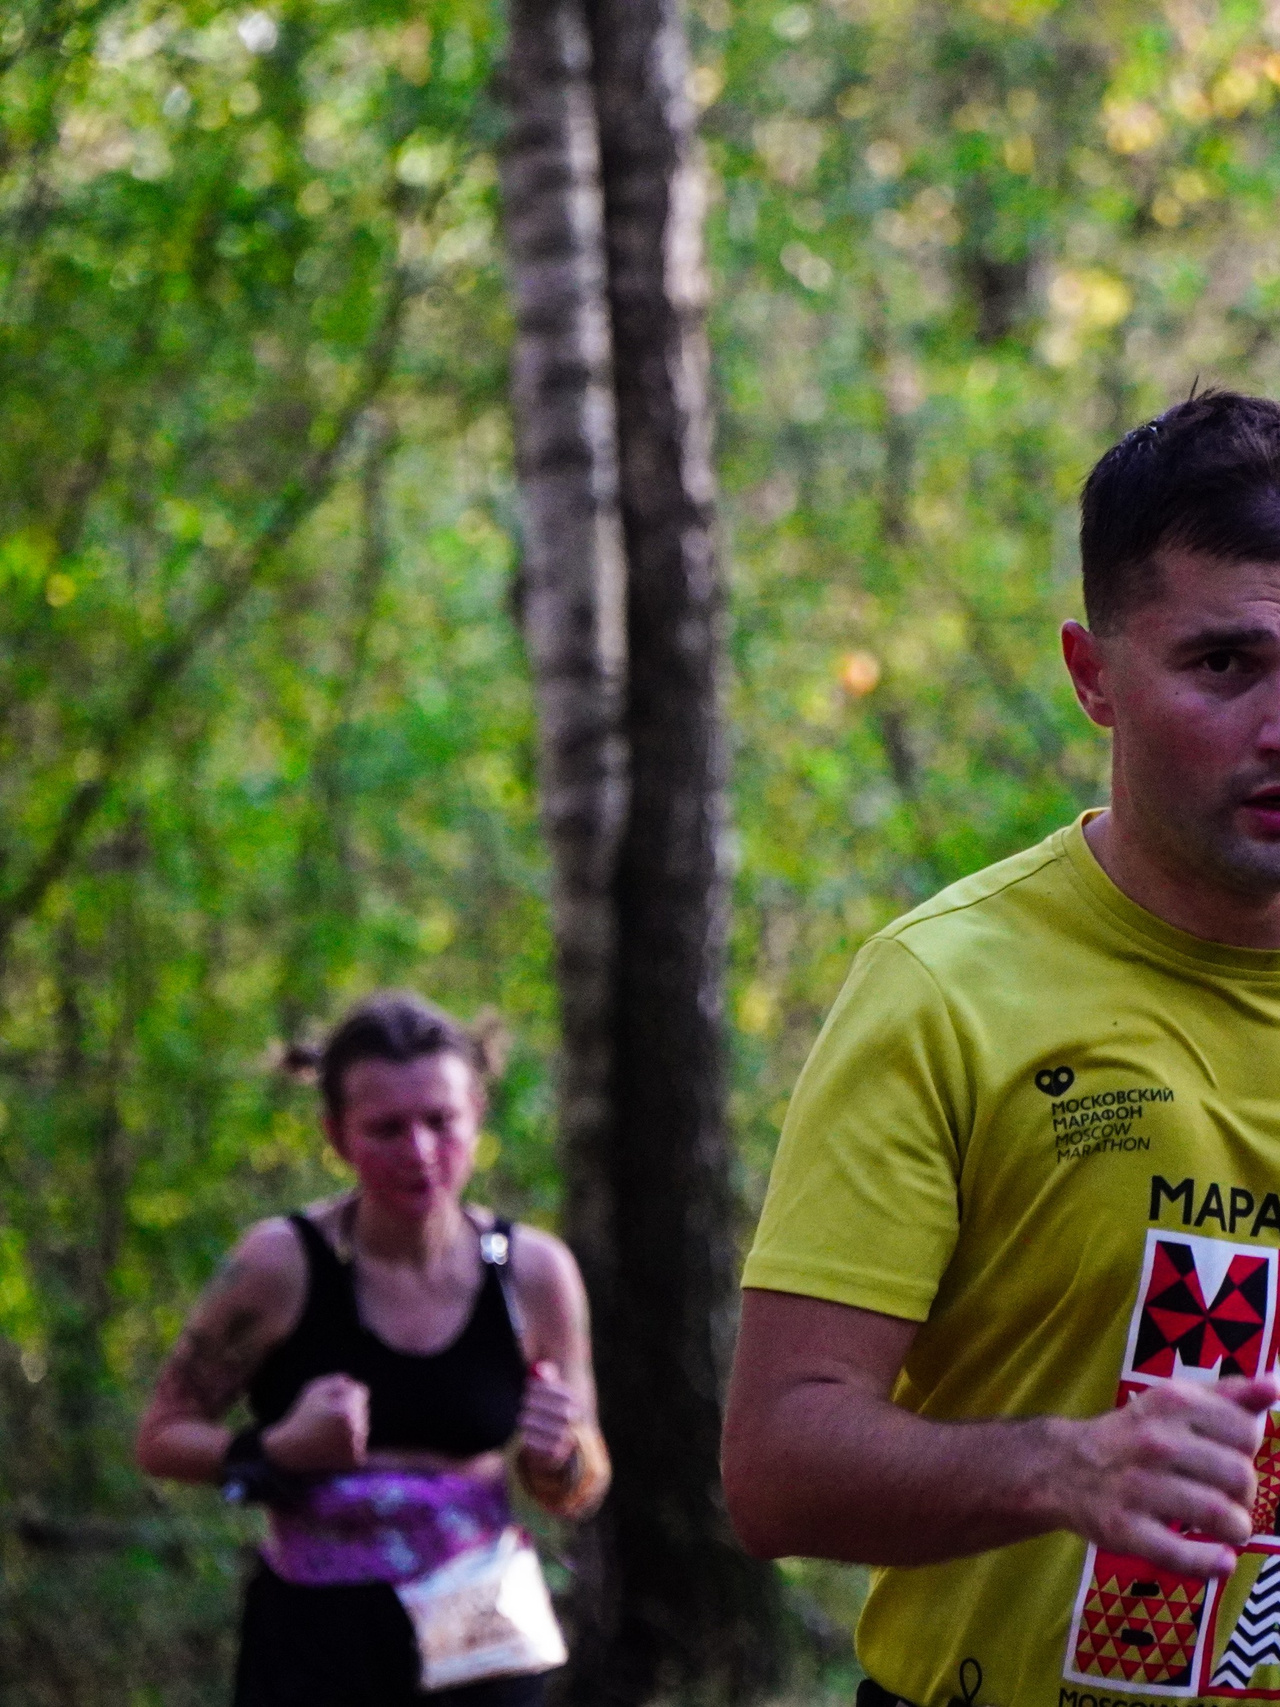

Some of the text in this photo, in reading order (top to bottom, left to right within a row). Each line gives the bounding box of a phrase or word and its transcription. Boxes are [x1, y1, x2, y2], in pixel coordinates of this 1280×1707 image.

[1051, 1087, 1175, 1116] МОСКОВСКИЙ
[1053, 1106, 1143, 1132] МАРАФОН
[1055, 1122, 1132, 1148] MOSCOW
[1057, 1137, 1151, 1163] MARATHON
